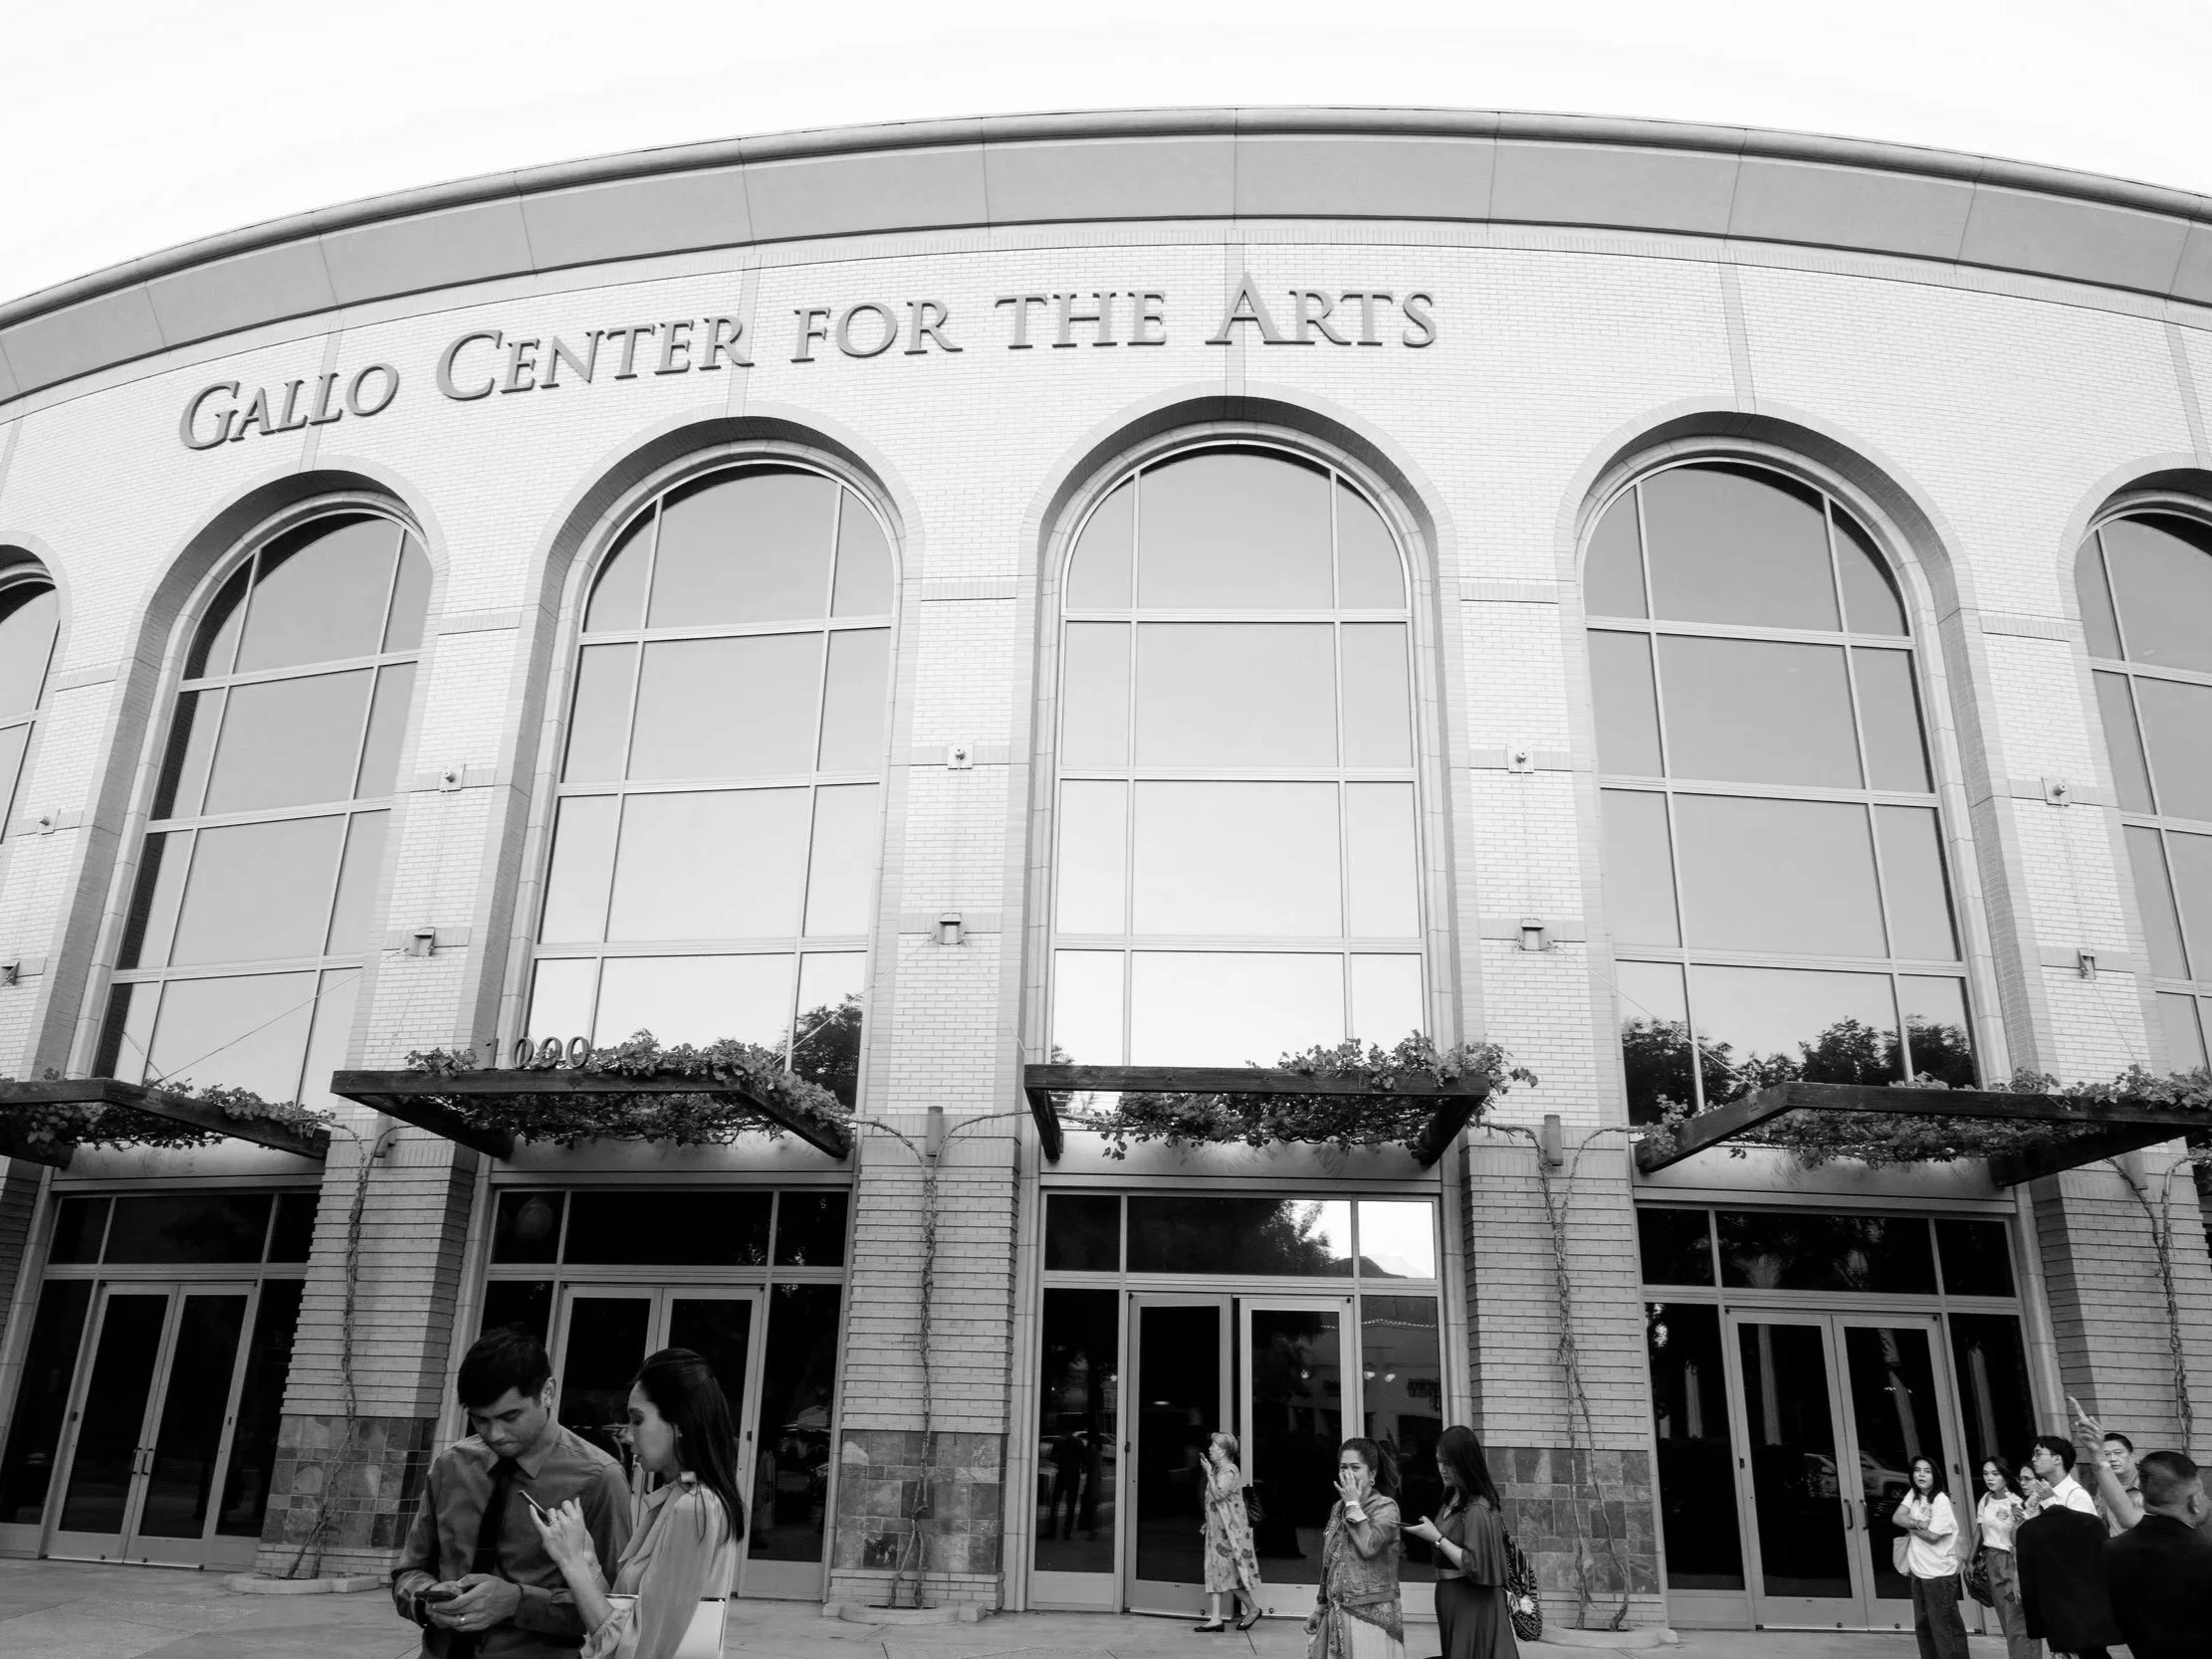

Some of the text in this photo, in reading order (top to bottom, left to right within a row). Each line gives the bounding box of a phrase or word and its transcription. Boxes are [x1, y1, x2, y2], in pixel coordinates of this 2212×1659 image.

[179, 271, 1438, 451] GALLO CENTER FOR THE ARTS
